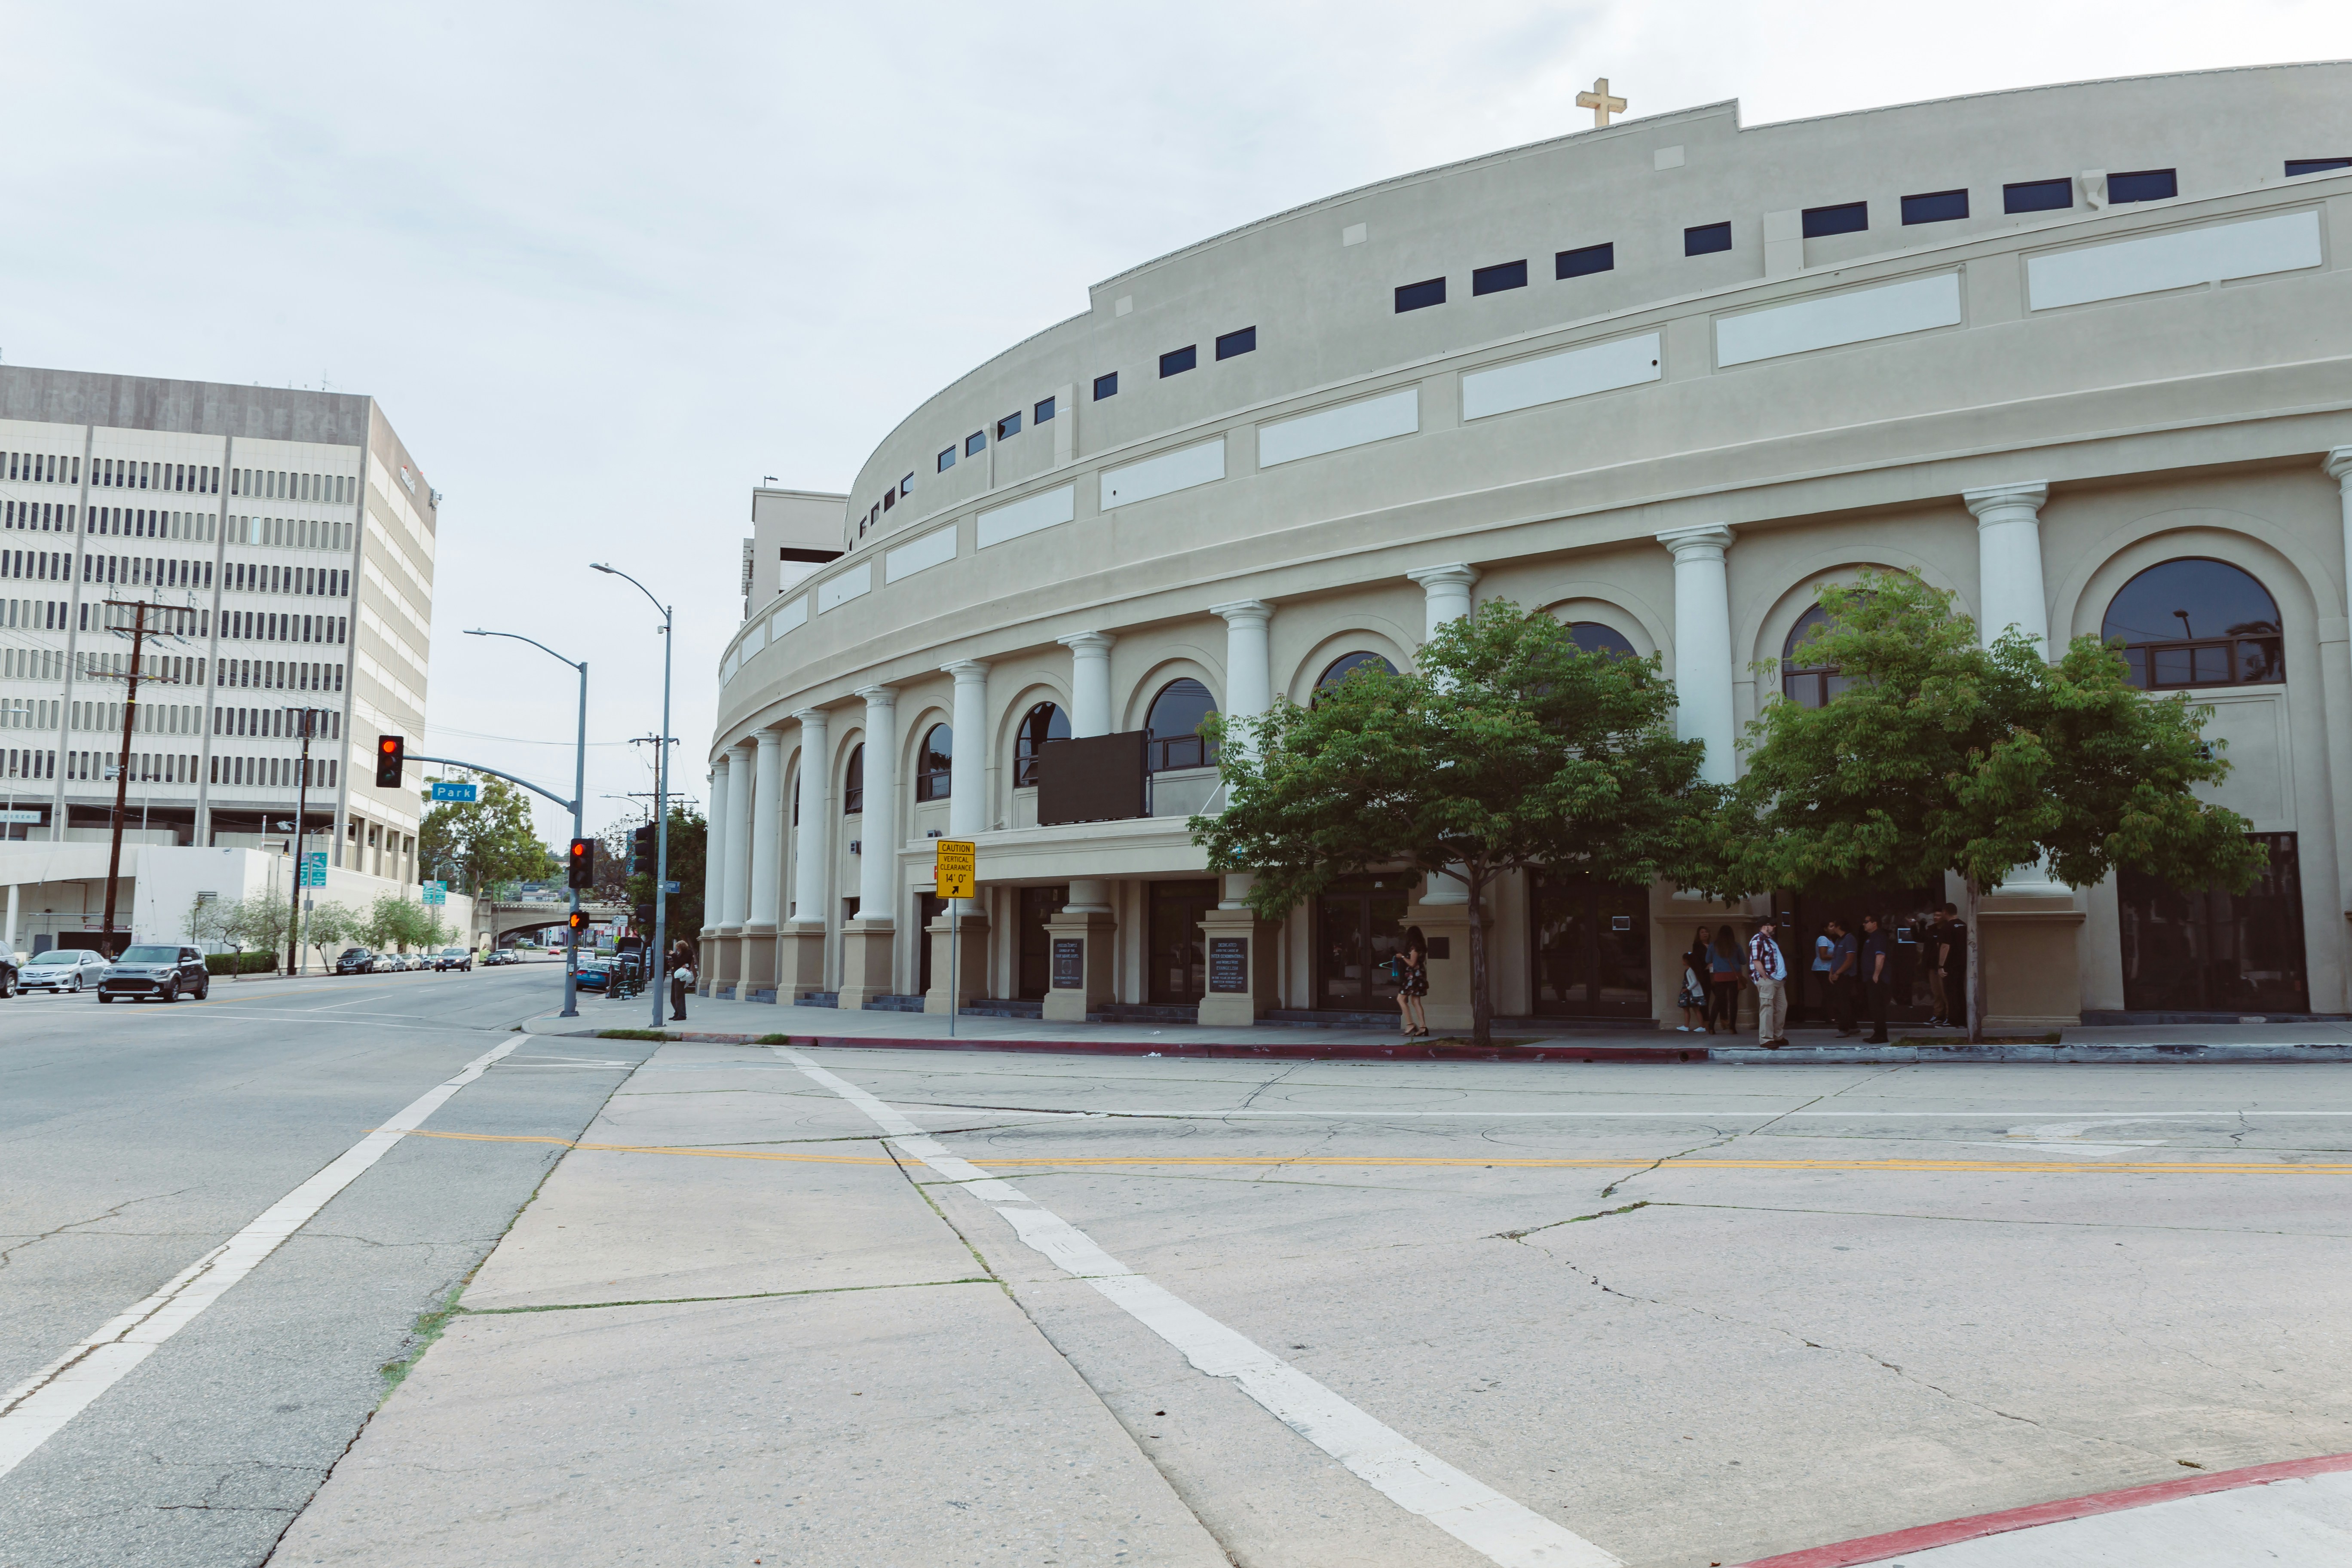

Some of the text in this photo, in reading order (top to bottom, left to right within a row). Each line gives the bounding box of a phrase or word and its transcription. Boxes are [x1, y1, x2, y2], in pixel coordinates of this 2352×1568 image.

[438, 787, 471, 797] Park
[942, 844, 970, 852] CAUTION
[946, 874, 966, 883] 14' 0"
